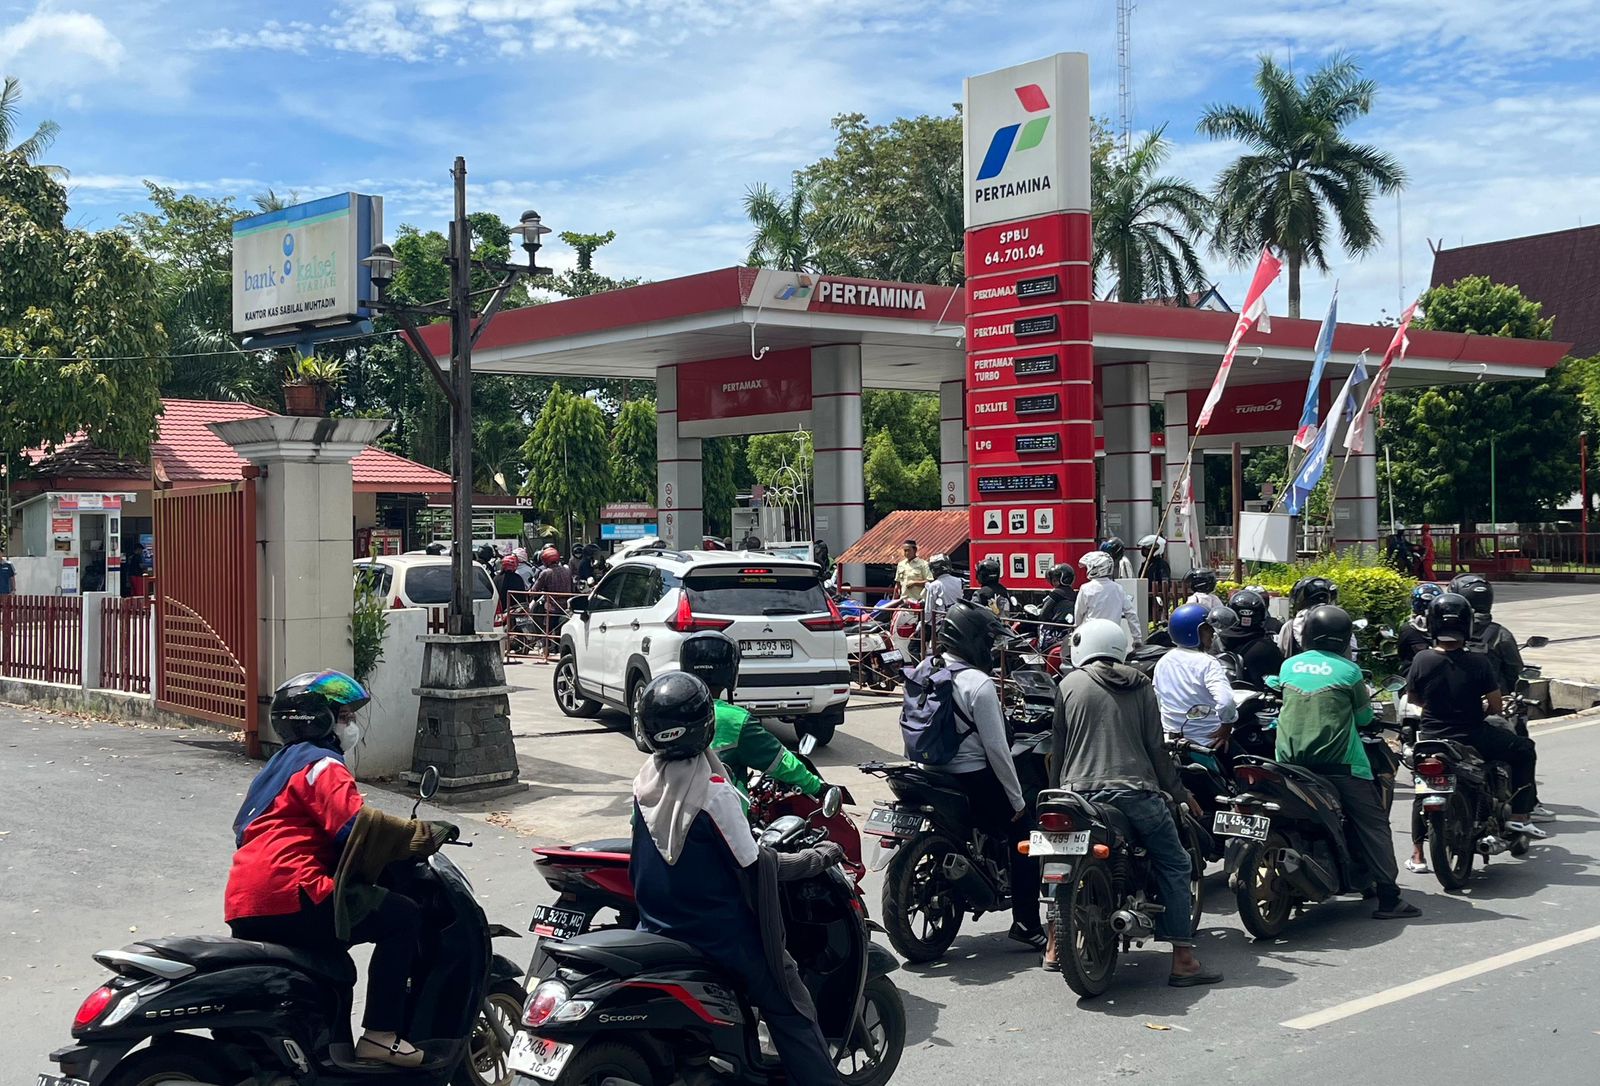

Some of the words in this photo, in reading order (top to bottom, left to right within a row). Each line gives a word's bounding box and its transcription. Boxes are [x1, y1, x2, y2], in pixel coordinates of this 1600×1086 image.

[975, 175, 1051, 204] PERTAMINA
[999, 228, 1029, 244] SPBU
[984, 243, 1045, 265] 64.701.04
[244, 265, 276, 291] bank
[818, 281, 926, 310] PERTAMINA
[973, 285, 1018, 300] PERTAMAX
[244, 309, 267, 321] KANTOR
[267, 306, 279, 317] KAS
[279, 302, 304, 315] SABILAL
[304, 297, 336, 311] MUHTADIN
[973, 323, 1016, 338] PERTALITE
[974, 357, 1014, 370] PERTAMAX
[974, 371, 1000, 382] TURBO
[722, 379, 762, 392] PERTAMAX
[974, 402, 1008, 414] DEXLITE
[1235, 404, 1274, 414] TURBO
[975, 440, 992, 451] LPG
[516, 497, 532, 506] LPG
[756, 641, 777, 651] 1693
[1292, 661, 1333, 676] Grab
[660, 730, 680, 739] GM
[1216, 813, 1228, 825] DA
[534, 907, 546, 920] DA
